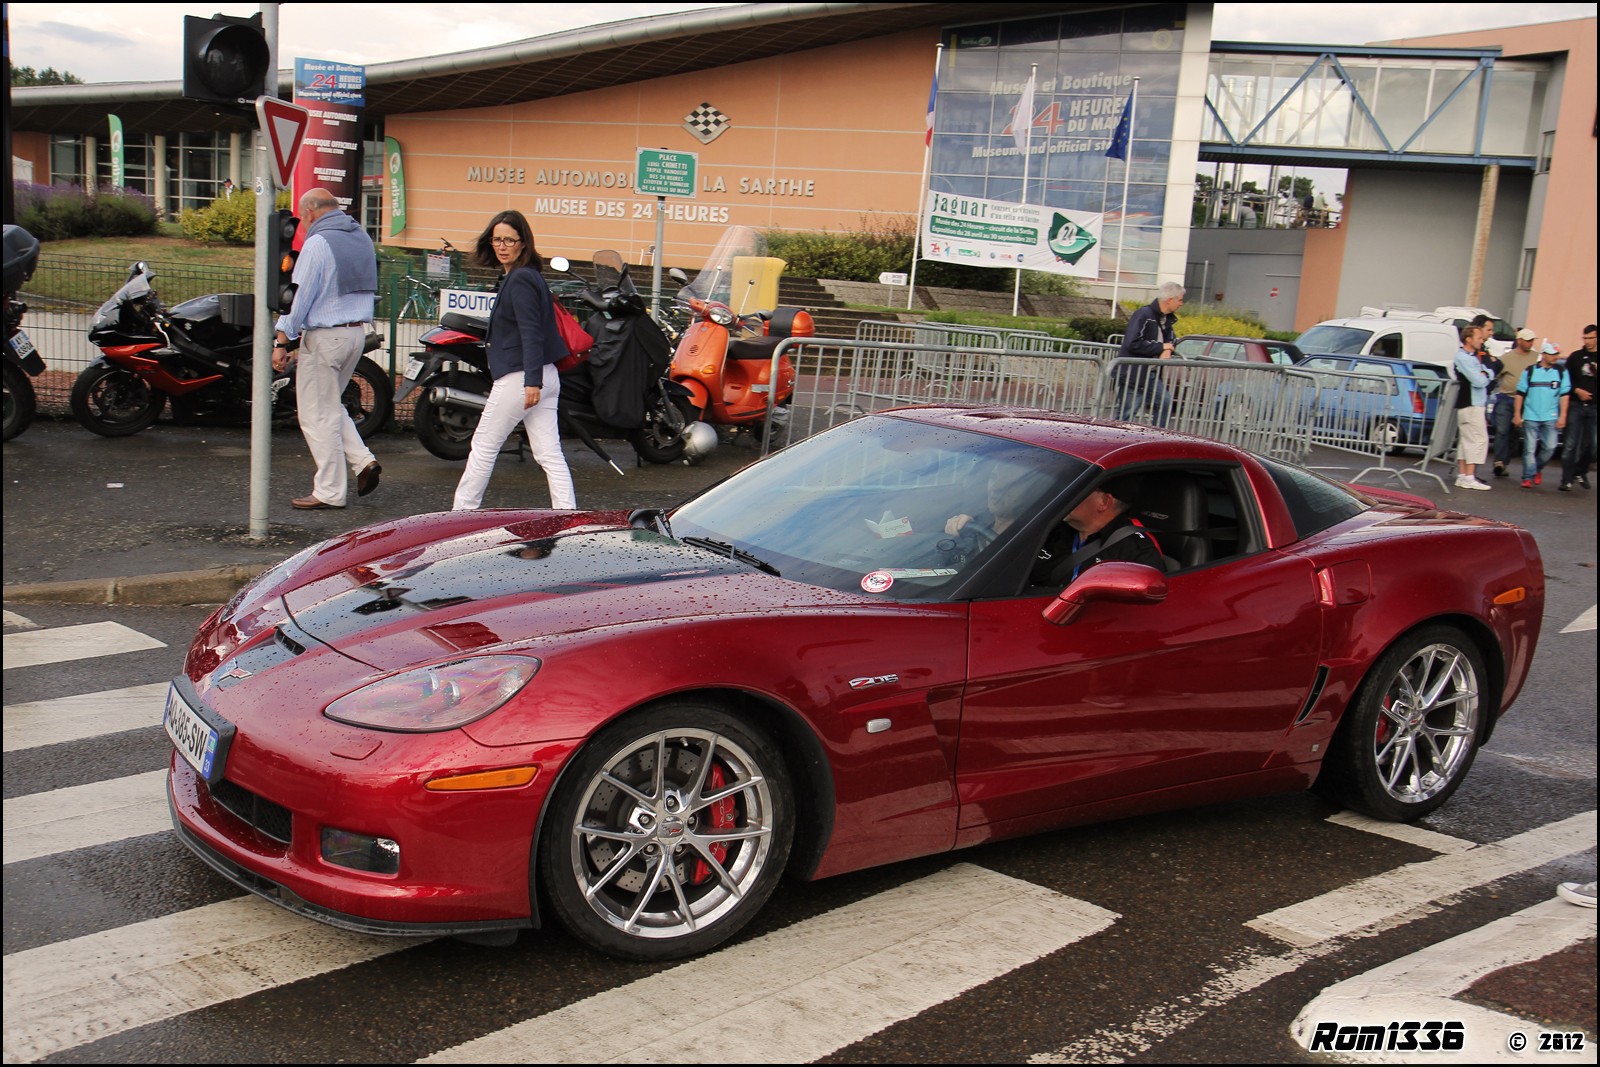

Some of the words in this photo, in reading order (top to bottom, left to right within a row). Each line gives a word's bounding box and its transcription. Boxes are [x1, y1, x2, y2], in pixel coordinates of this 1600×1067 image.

[309, 74, 337, 88] 24
[1042, 77, 1058, 91] et
[1062, 72, 1132, 91] Boutique
[1067, 119, 1088, 132] DU
[972, 146, 1019, 158] Museum
[1049, 140, 1091, 153] official
[467, 166, 526, 184] MUSEE
[535, 169, 634, 188] AUTOMOBI
[704, 176, 726, 194] LA
[738, 176, 815, 197] SARTHE
[535, 198, 588, 215] MUSEE
[595, 200, 625, 218] DES
[632, 203, 653, 218] 24
[664, 205, 729, 223] HEURES
[932, 194, 988, 216] Jaguar
